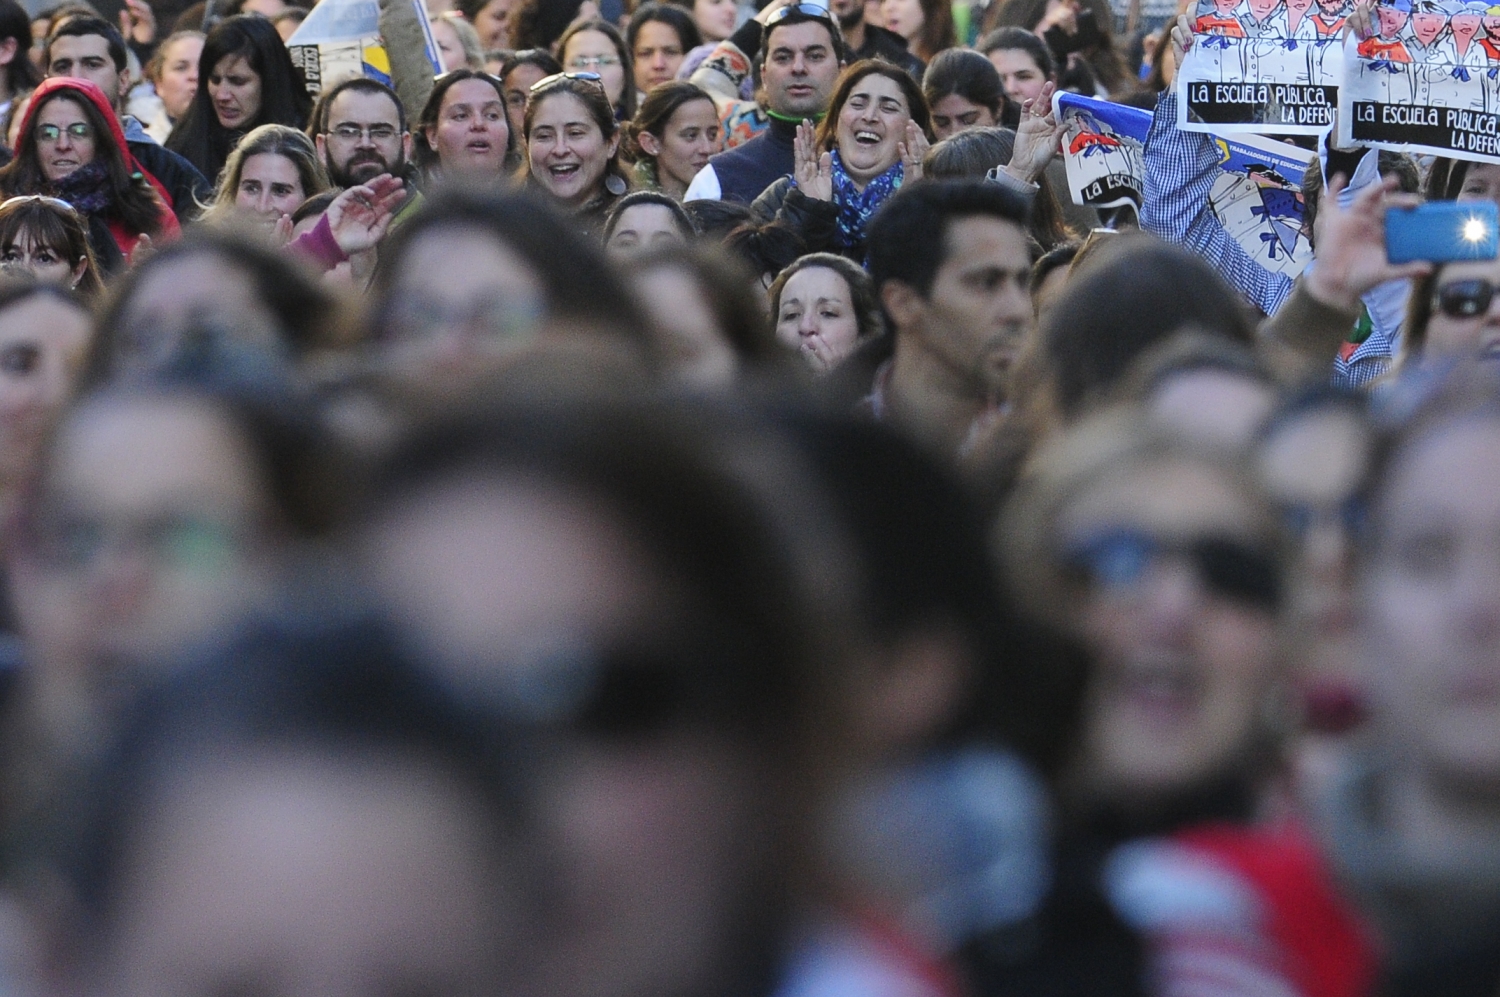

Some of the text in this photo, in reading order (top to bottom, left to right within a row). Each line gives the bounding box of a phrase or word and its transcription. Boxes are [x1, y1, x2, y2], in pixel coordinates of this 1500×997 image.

[1281, 106, 1296, 123] LA
[1451, 131, 1466, 149] LA
[1229, 145, 1271, 163] TRABAJADORES
[1271, 157, 1280, 165] DE
